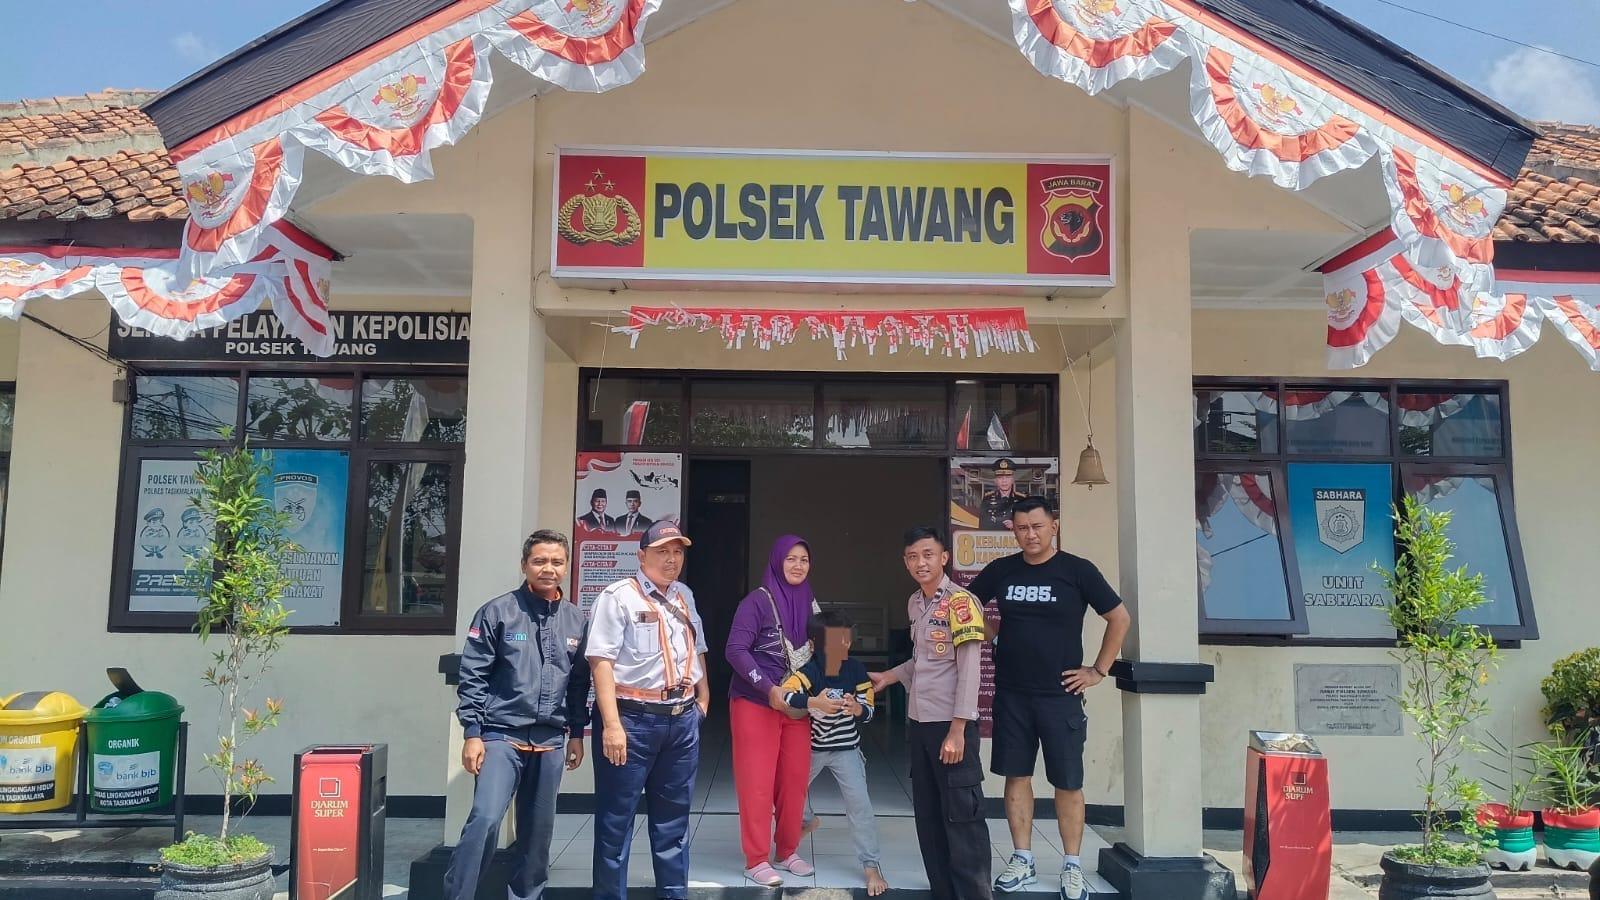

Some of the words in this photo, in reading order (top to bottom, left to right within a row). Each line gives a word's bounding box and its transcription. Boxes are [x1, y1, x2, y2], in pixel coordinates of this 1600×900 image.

[1048, 179, 1069, 189] JAWA
[1070, 179, 1096, 189] BARAT
[653, 182, 825, 240] POLSEK
[837, 184, 1015, 244] TAWANG
[225, 342, 296, 355] POLSEK
[147, 474, 177, 485] POLSEK
[1316, 490, 1363, 500] SABHARA
[957, 534, 975, 566] 8
[1322, 576, 1364, 589] UNIT
[1005, 585, 1057, 602] 1985.
[1304, 593, 1385, 607] SABHARA
[8, 735, 41, 745] ORGANIK
[108, 738, 140, 749] ORGANIK
[10, 764, 32, 774] bank
[35, 763, 52, 773] bjb
[116, 771, 139, 780] bank
[141, 768, 157, 778] bjb
[310, 800, 349, 809] DJARUM
[314, 809, 344, 818] SUPER
